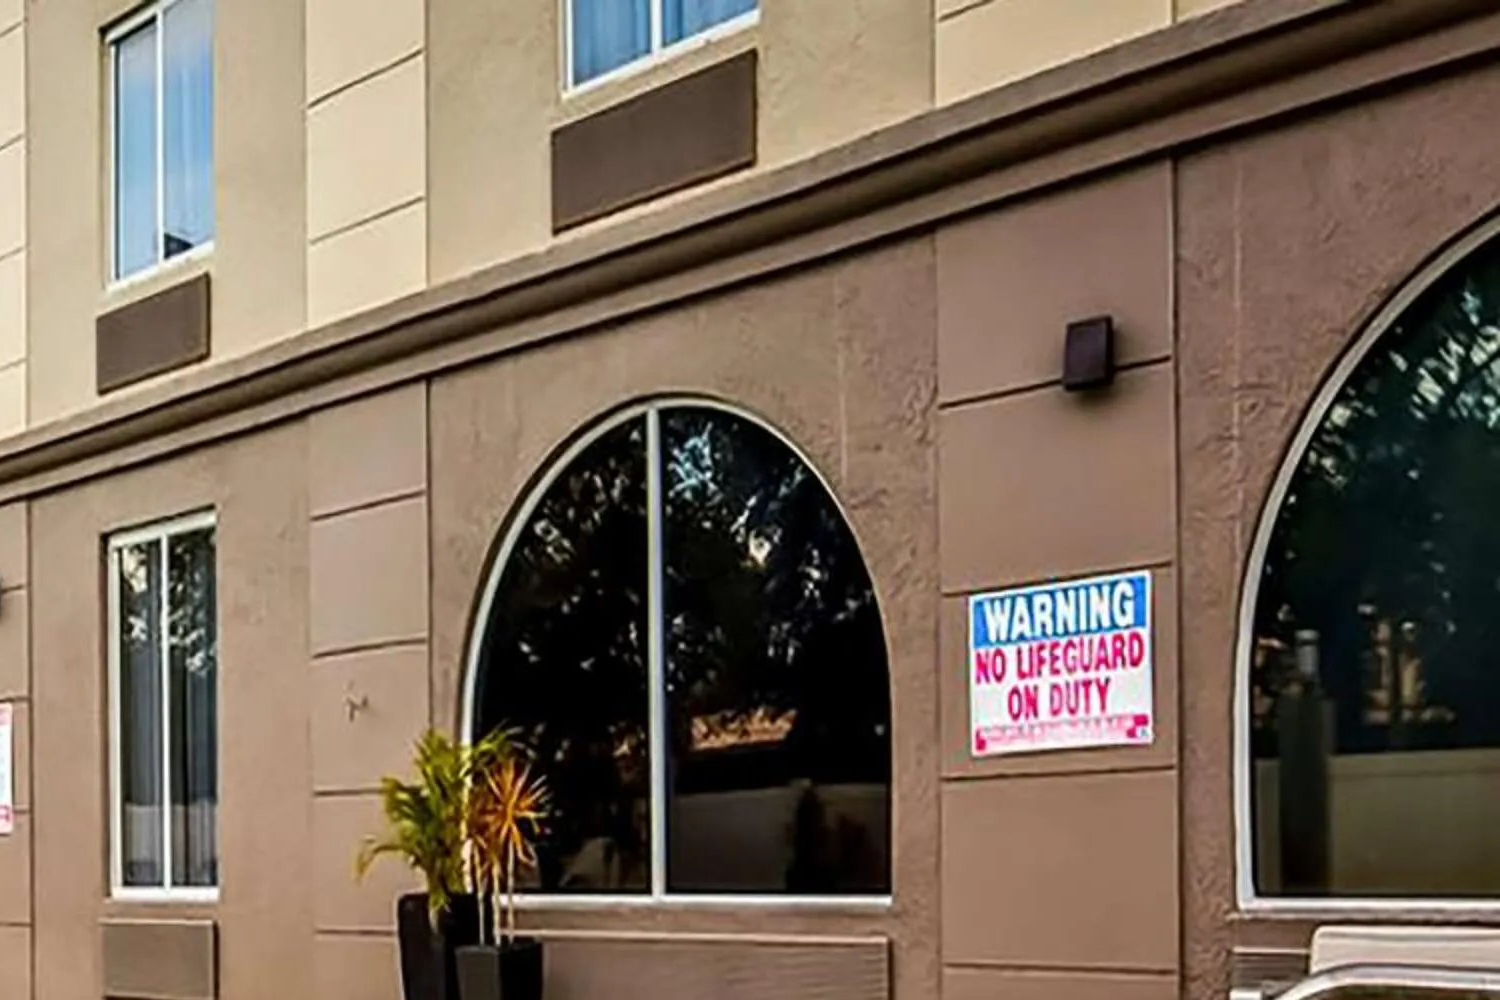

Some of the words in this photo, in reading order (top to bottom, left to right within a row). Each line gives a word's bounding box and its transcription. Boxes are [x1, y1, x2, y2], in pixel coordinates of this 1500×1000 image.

[984, 579, 1135, 644] WARNING
[975, 648, 1007, 685] NO
[1016, 631, 1145, 681] LIFEGUARD
[1007, 684, 1039, 722] ON
[1049, 676, 1111, 717] DUTY
